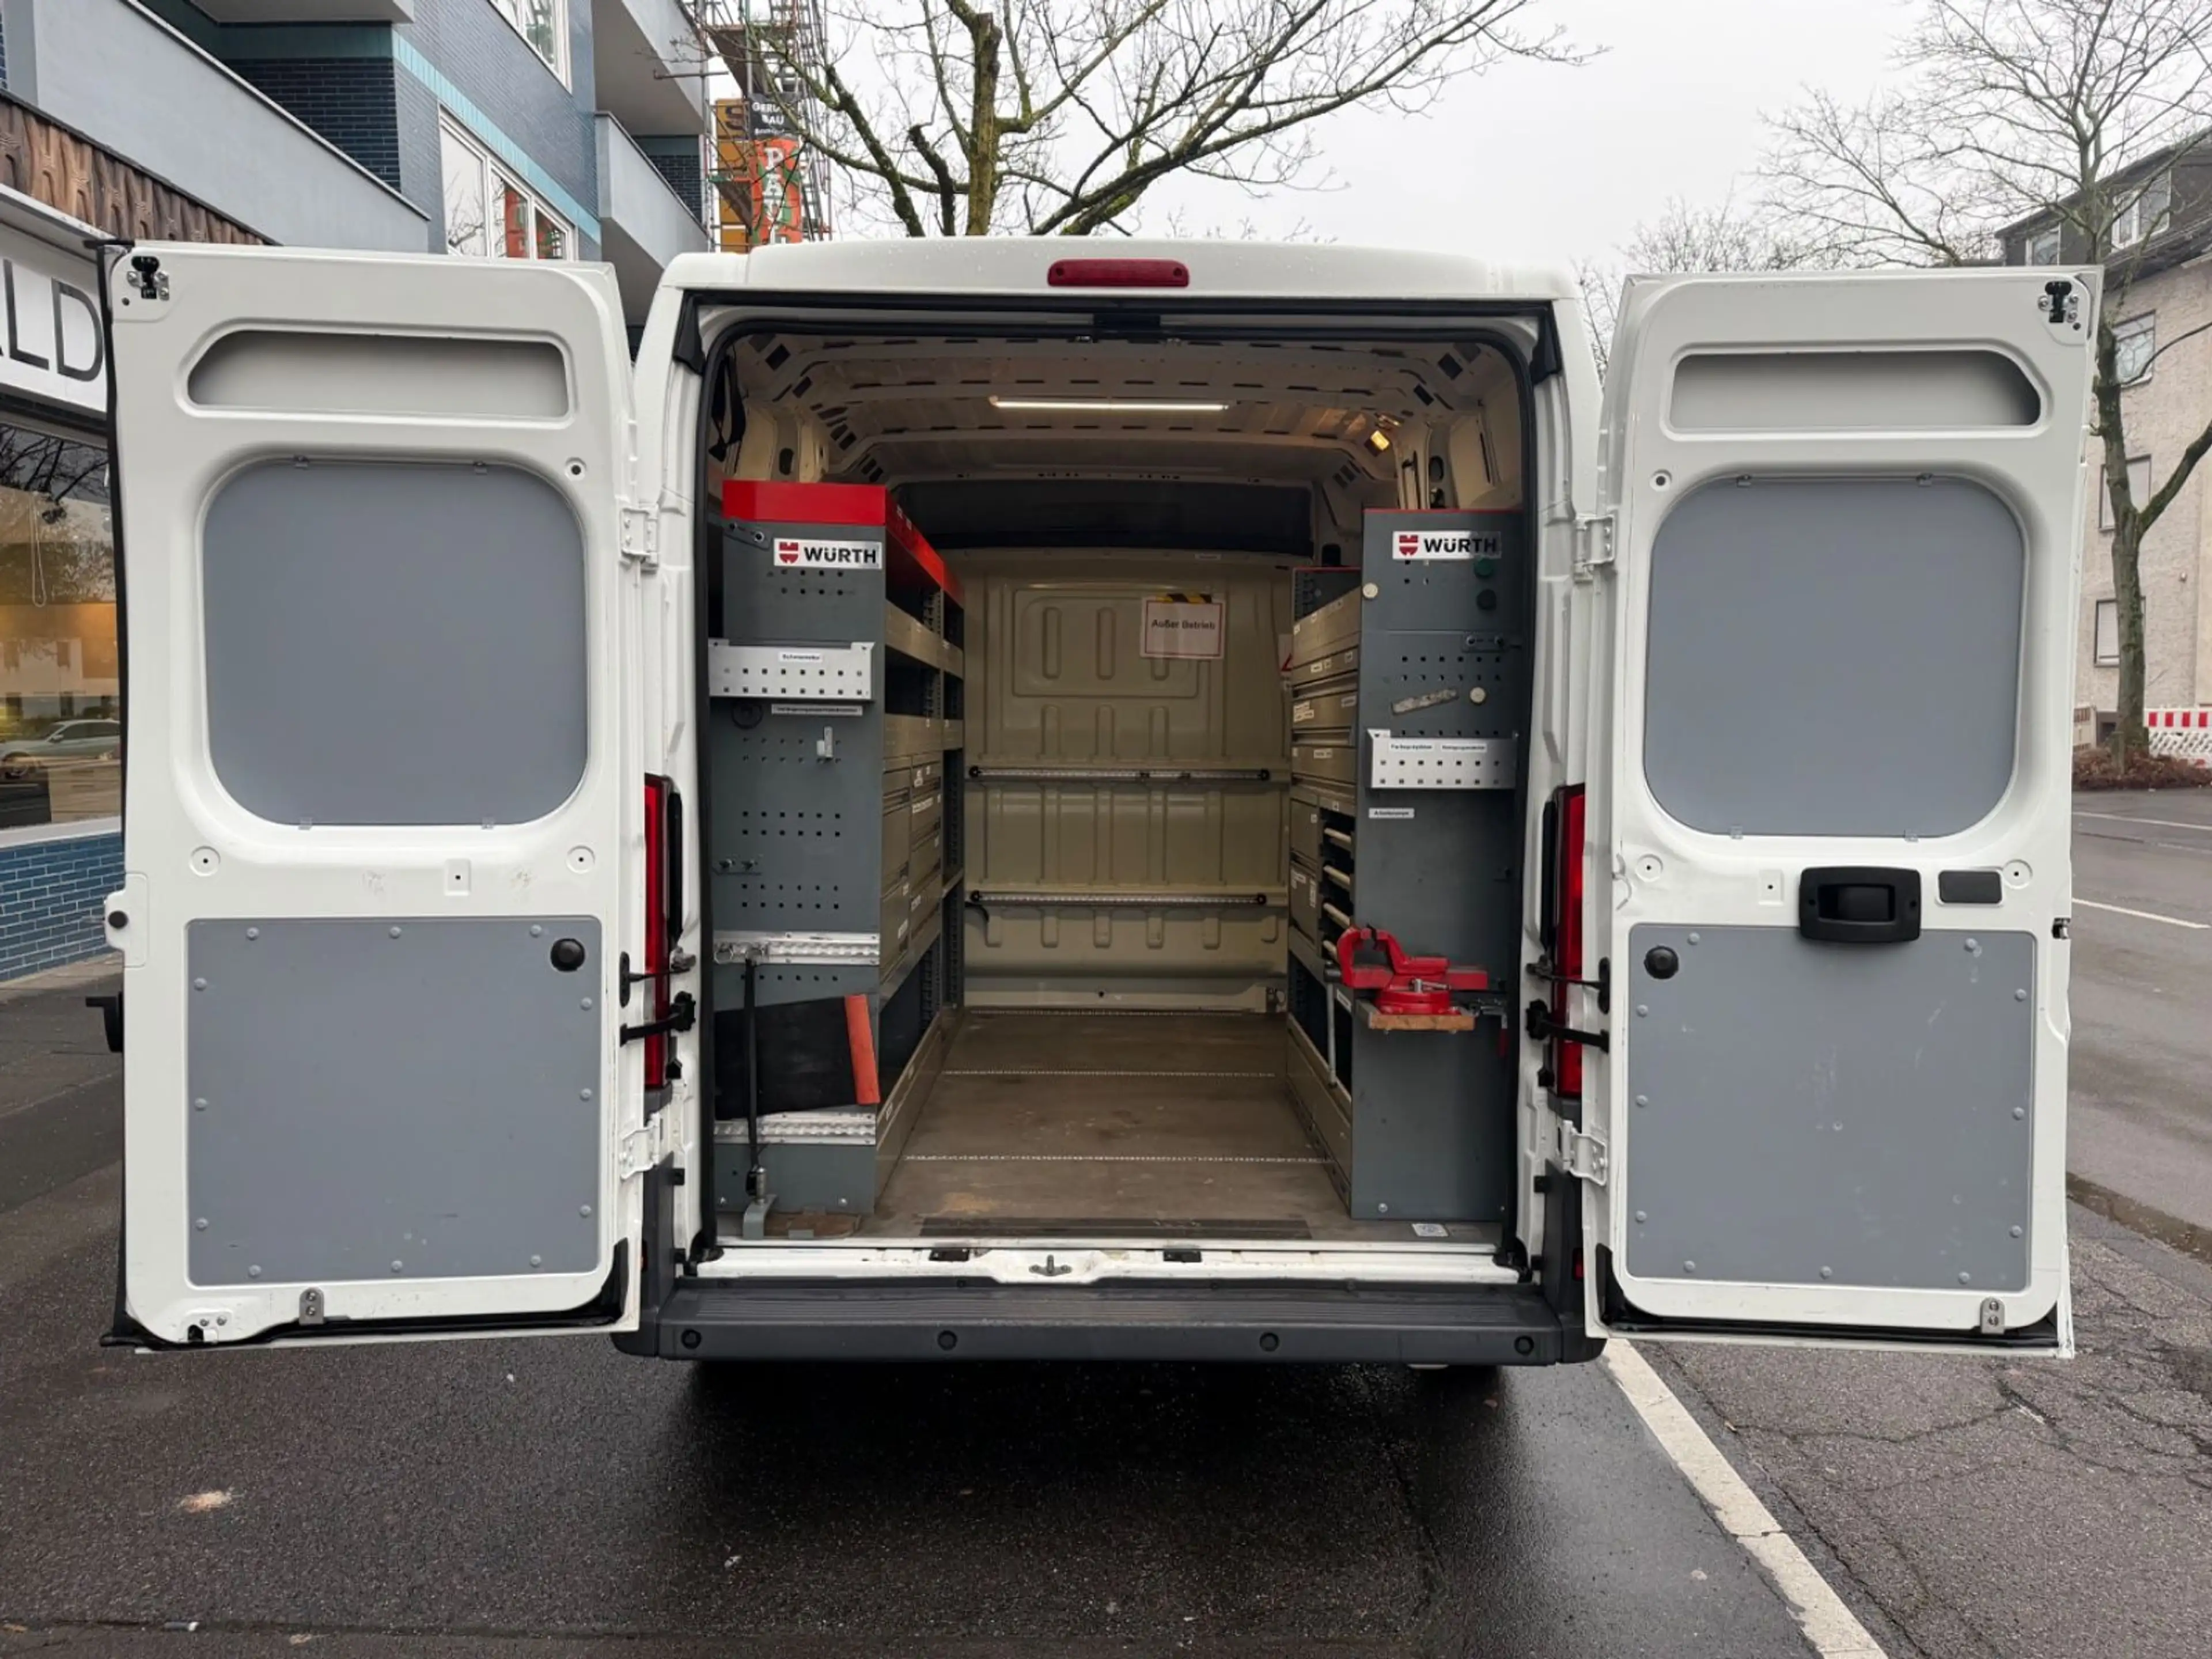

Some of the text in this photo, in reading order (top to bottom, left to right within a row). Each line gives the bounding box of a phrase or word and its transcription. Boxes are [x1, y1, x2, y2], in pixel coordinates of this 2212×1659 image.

[0, 259, 104, 382] LD
[1424, 538, 1497, 553] WÜRTH
[804, 546, 877, 564] WÜRTH
[1152, 619, 1216, 630] Außer Betrieb
